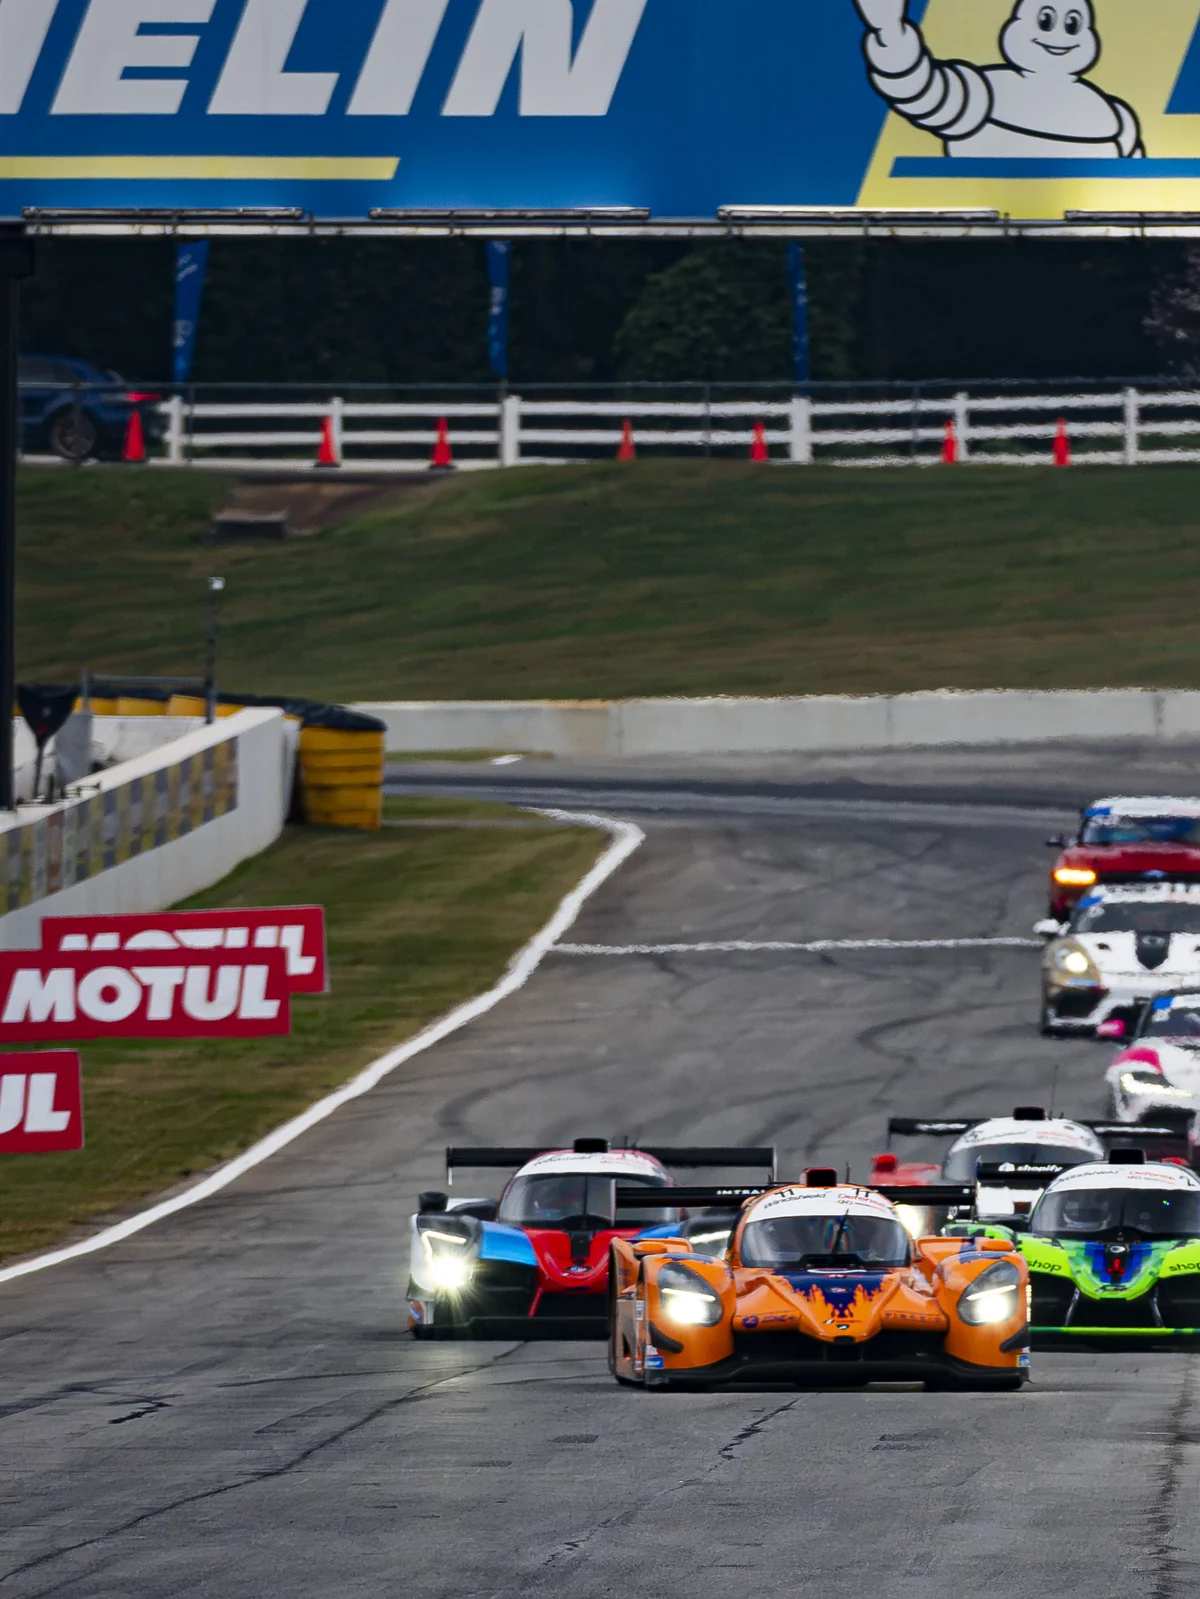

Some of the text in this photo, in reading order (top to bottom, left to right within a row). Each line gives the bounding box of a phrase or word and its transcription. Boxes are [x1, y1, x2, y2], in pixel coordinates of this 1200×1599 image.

[3, 965, 281, 1023] MOTUL
[1017, 1164, 1063, 1173] shopify
[1027, 1259, 1062, 1272] shop
